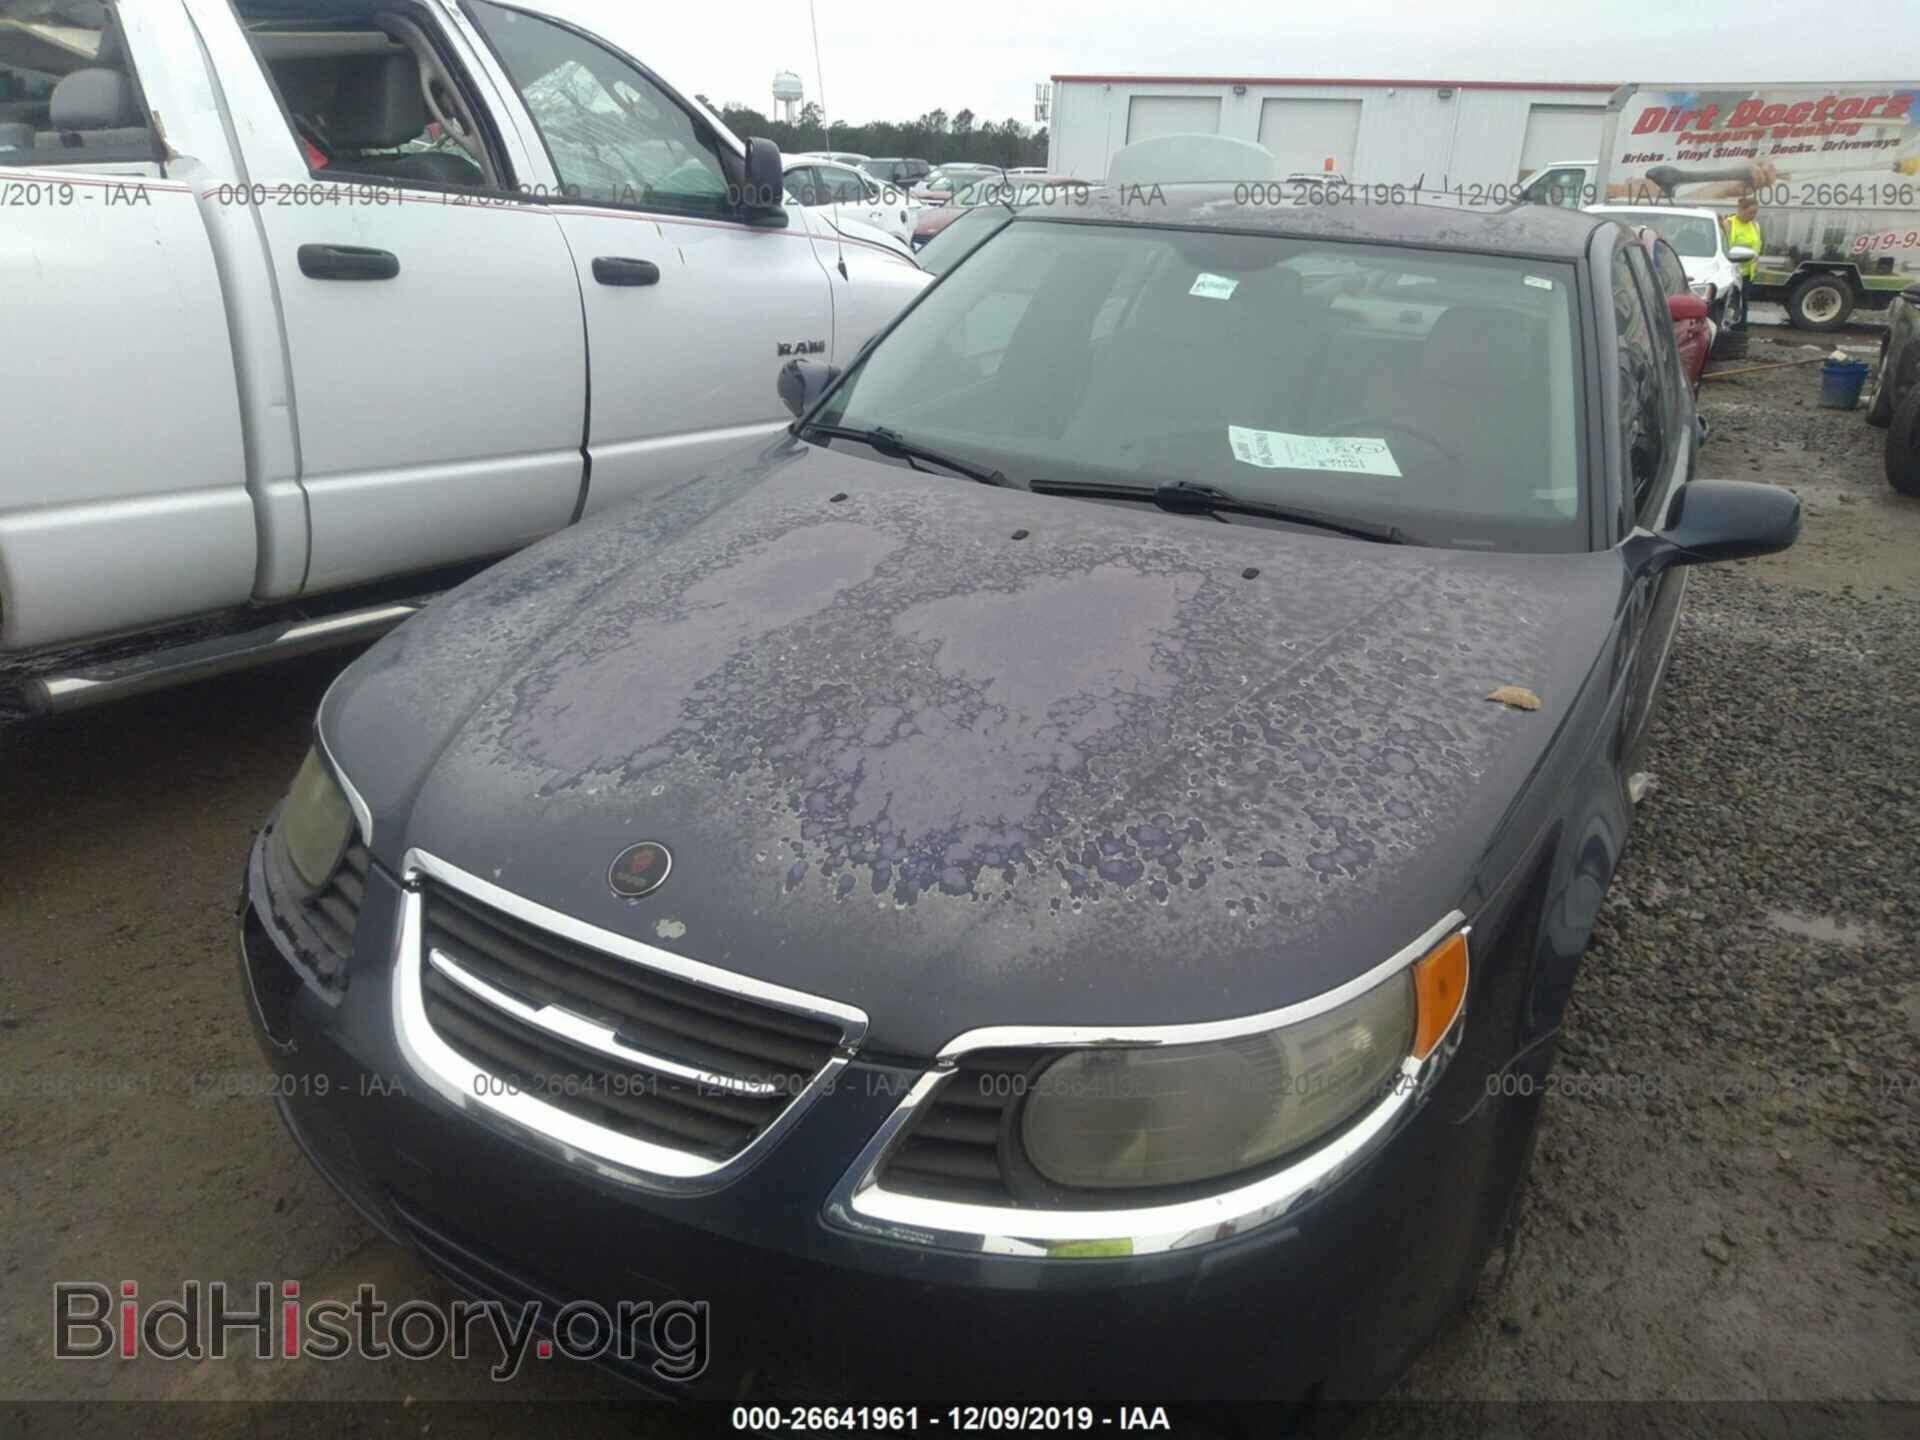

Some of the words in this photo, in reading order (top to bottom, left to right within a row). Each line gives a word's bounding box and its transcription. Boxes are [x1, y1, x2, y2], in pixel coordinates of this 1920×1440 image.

[1631, 105, 1721, 135] Dirt
[1726, 96, 1914, 129] Doctors
[1621, 152, 1665, 163] Bricks
[1676, 149, 1712, 161] Vinyl
[1713, 147, 1758, 159] Siding
[1821, 138, 1902, 152] Driveways
[778, 340, 825, 356] RAM
